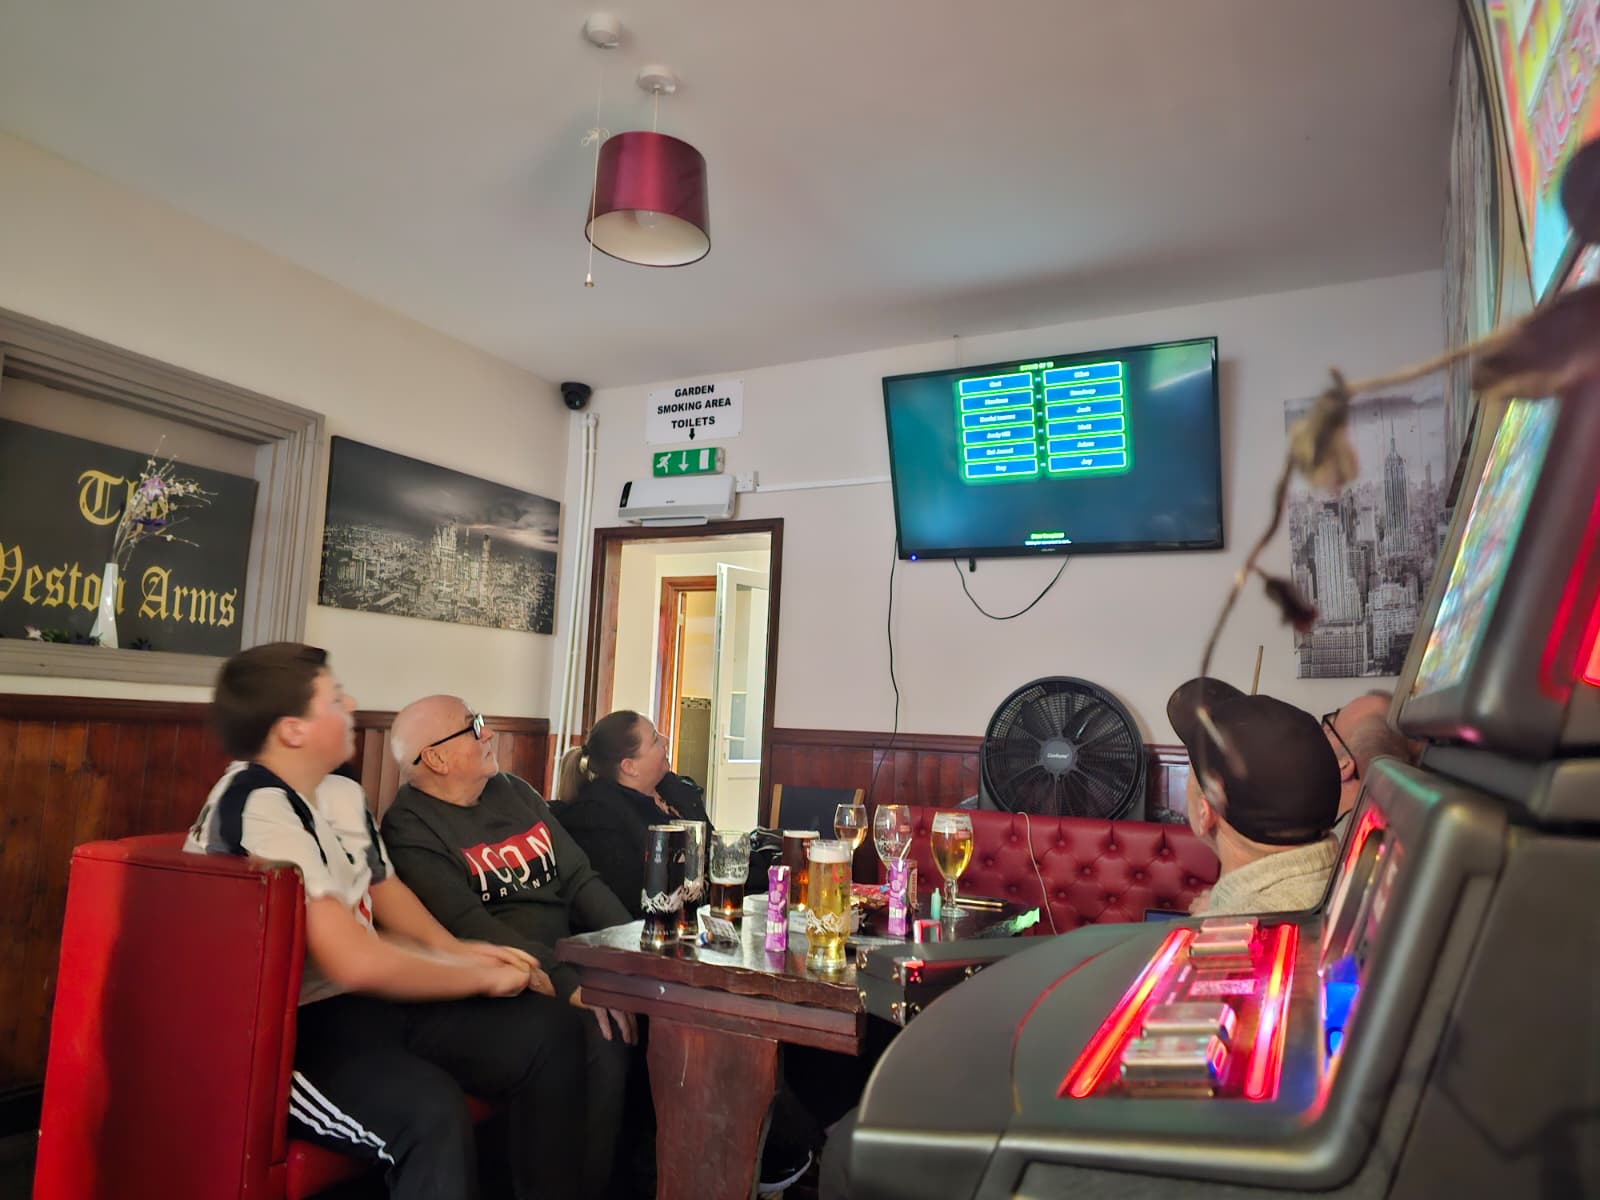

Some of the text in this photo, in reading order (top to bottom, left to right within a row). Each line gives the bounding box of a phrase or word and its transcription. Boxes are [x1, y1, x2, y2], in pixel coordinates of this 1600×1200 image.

[674, 384, 715, 398] GARDEN
[657, 397, 732, 415] SMOKING AREA
[671, 415, 716, 430] TOILETS
[138, 565, 238, 628] Arms
[464, 826, 557, 892] ICON
[482, 868, 559, 902] ORINA
